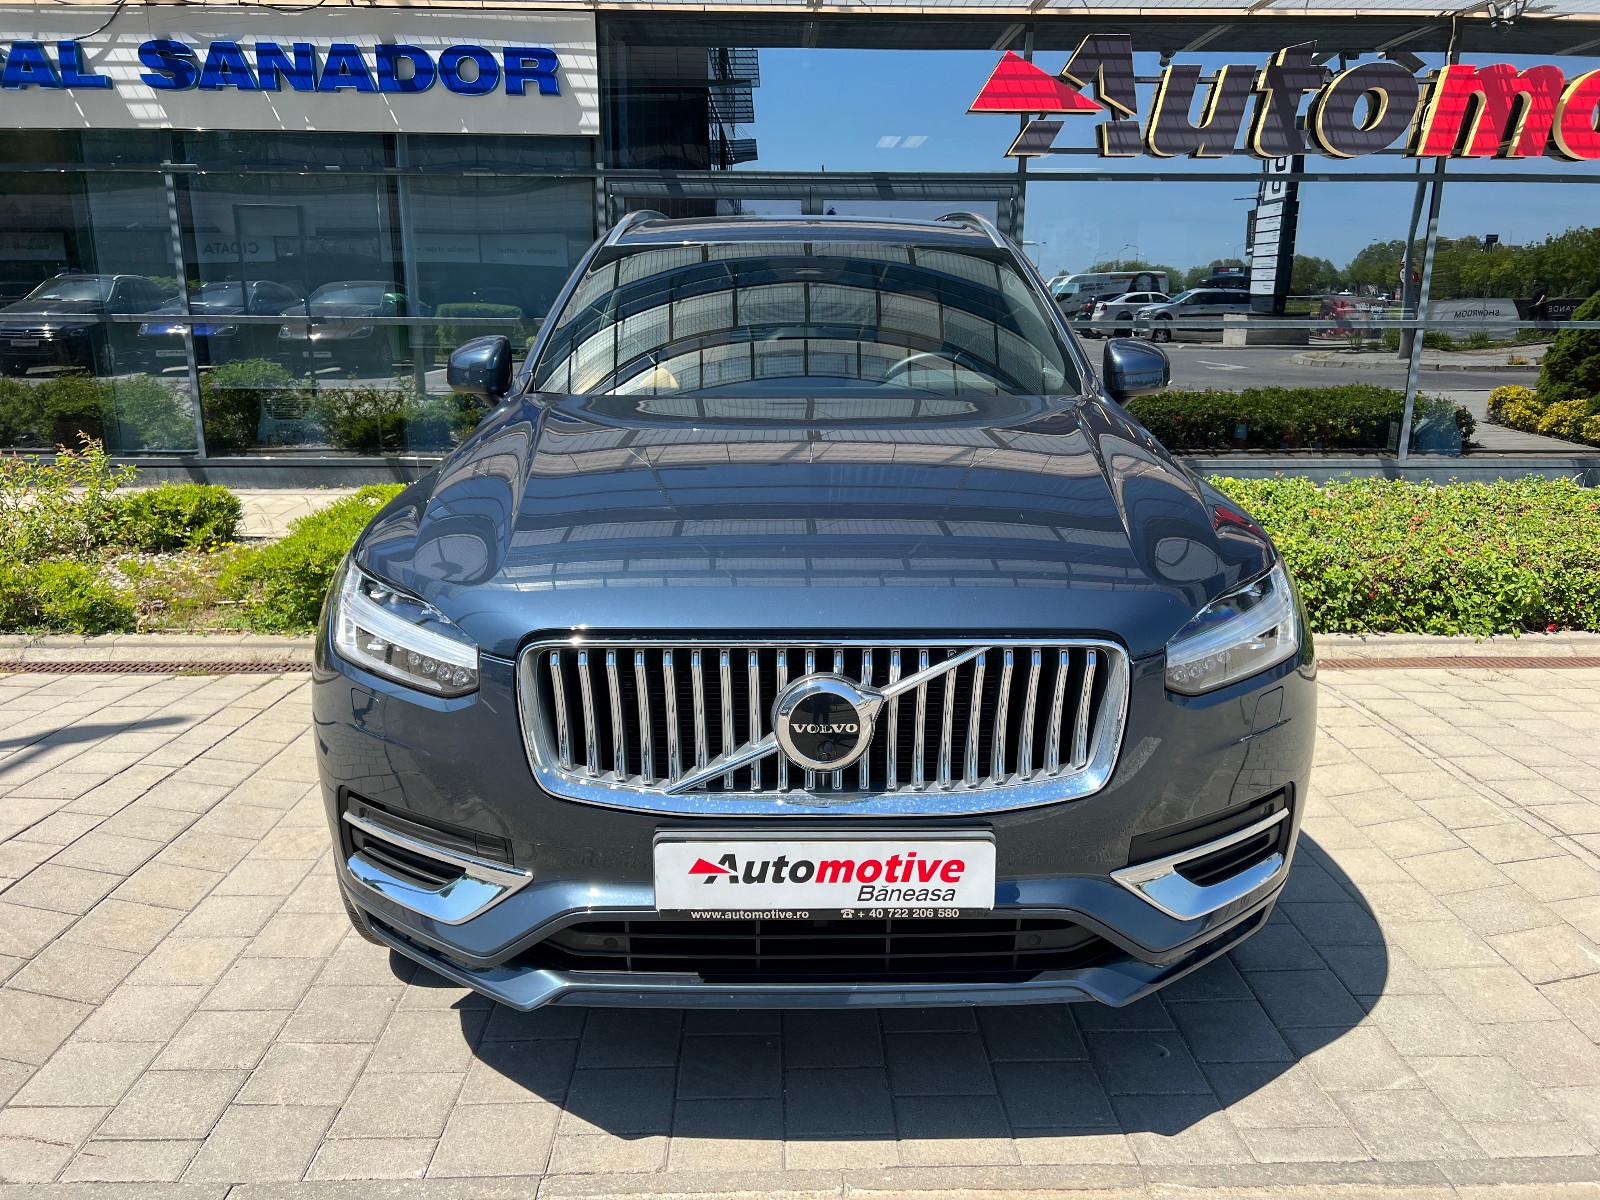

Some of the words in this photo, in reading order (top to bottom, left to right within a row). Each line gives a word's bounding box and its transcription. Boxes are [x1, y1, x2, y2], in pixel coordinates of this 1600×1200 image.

[0, 40, 113, 90] AL
[137, 39, 562, 97] SANADOR
[790, 723, 858, 734] VOLVO
[688, 851, 966, 885] Automotive
[857, 885, 956, 902] Băneasa
[690, 909, 810, 920] www.automotive.ro
[868, 909, 883, 918] 40
[887, 909, 909, 918] 722
[912, 909, 934, 918] 206
[937, 909, 959, 918] 580
